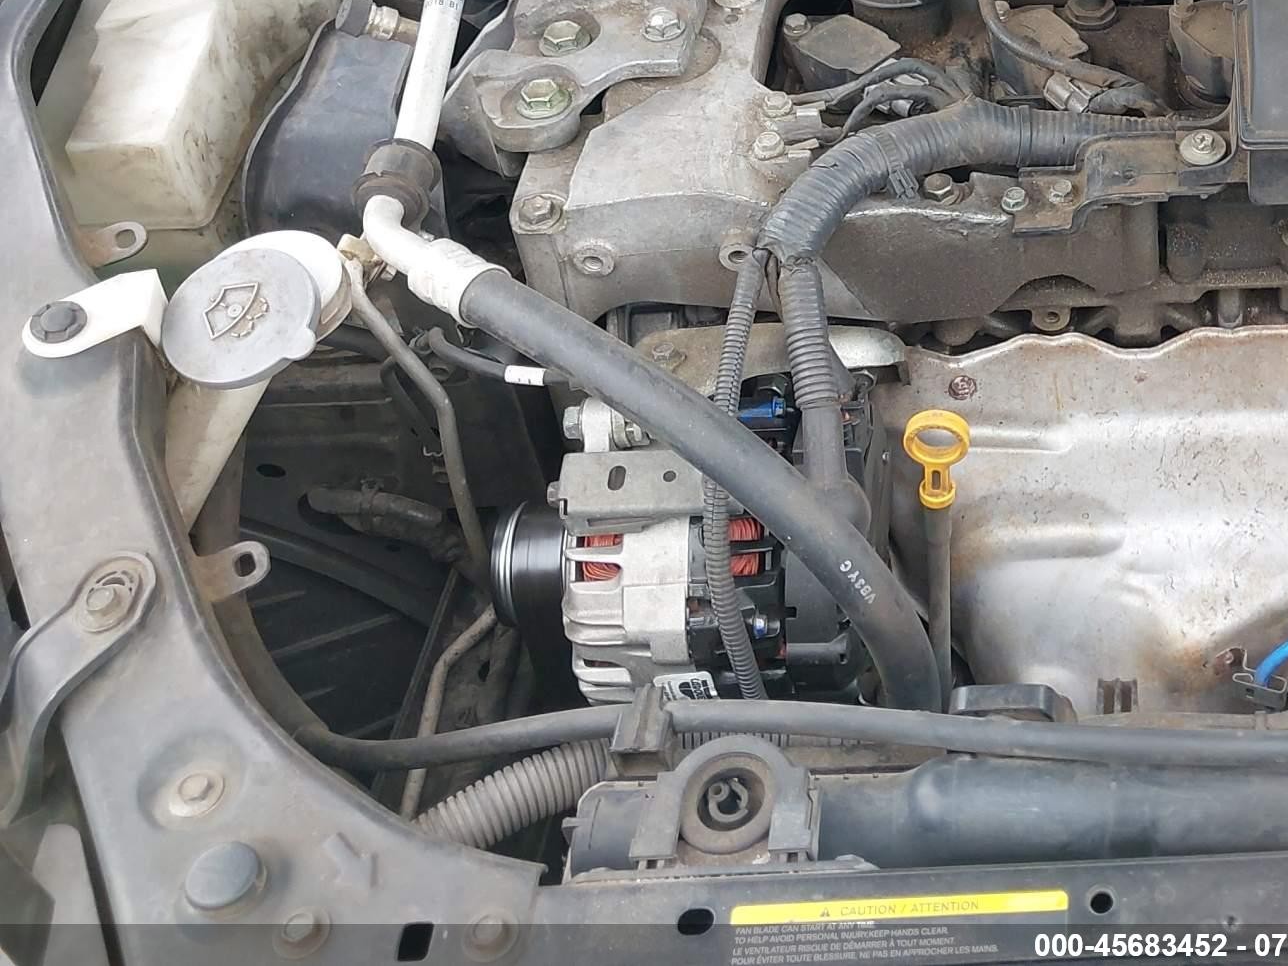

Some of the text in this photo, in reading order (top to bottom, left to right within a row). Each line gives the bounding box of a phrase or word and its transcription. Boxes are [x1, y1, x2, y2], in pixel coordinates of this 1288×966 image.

[840, 905, 896, 916] CAUTION
[911, 901, 979, 913] ATTENTION
[796, 932, 839, 941] PERSONAL
